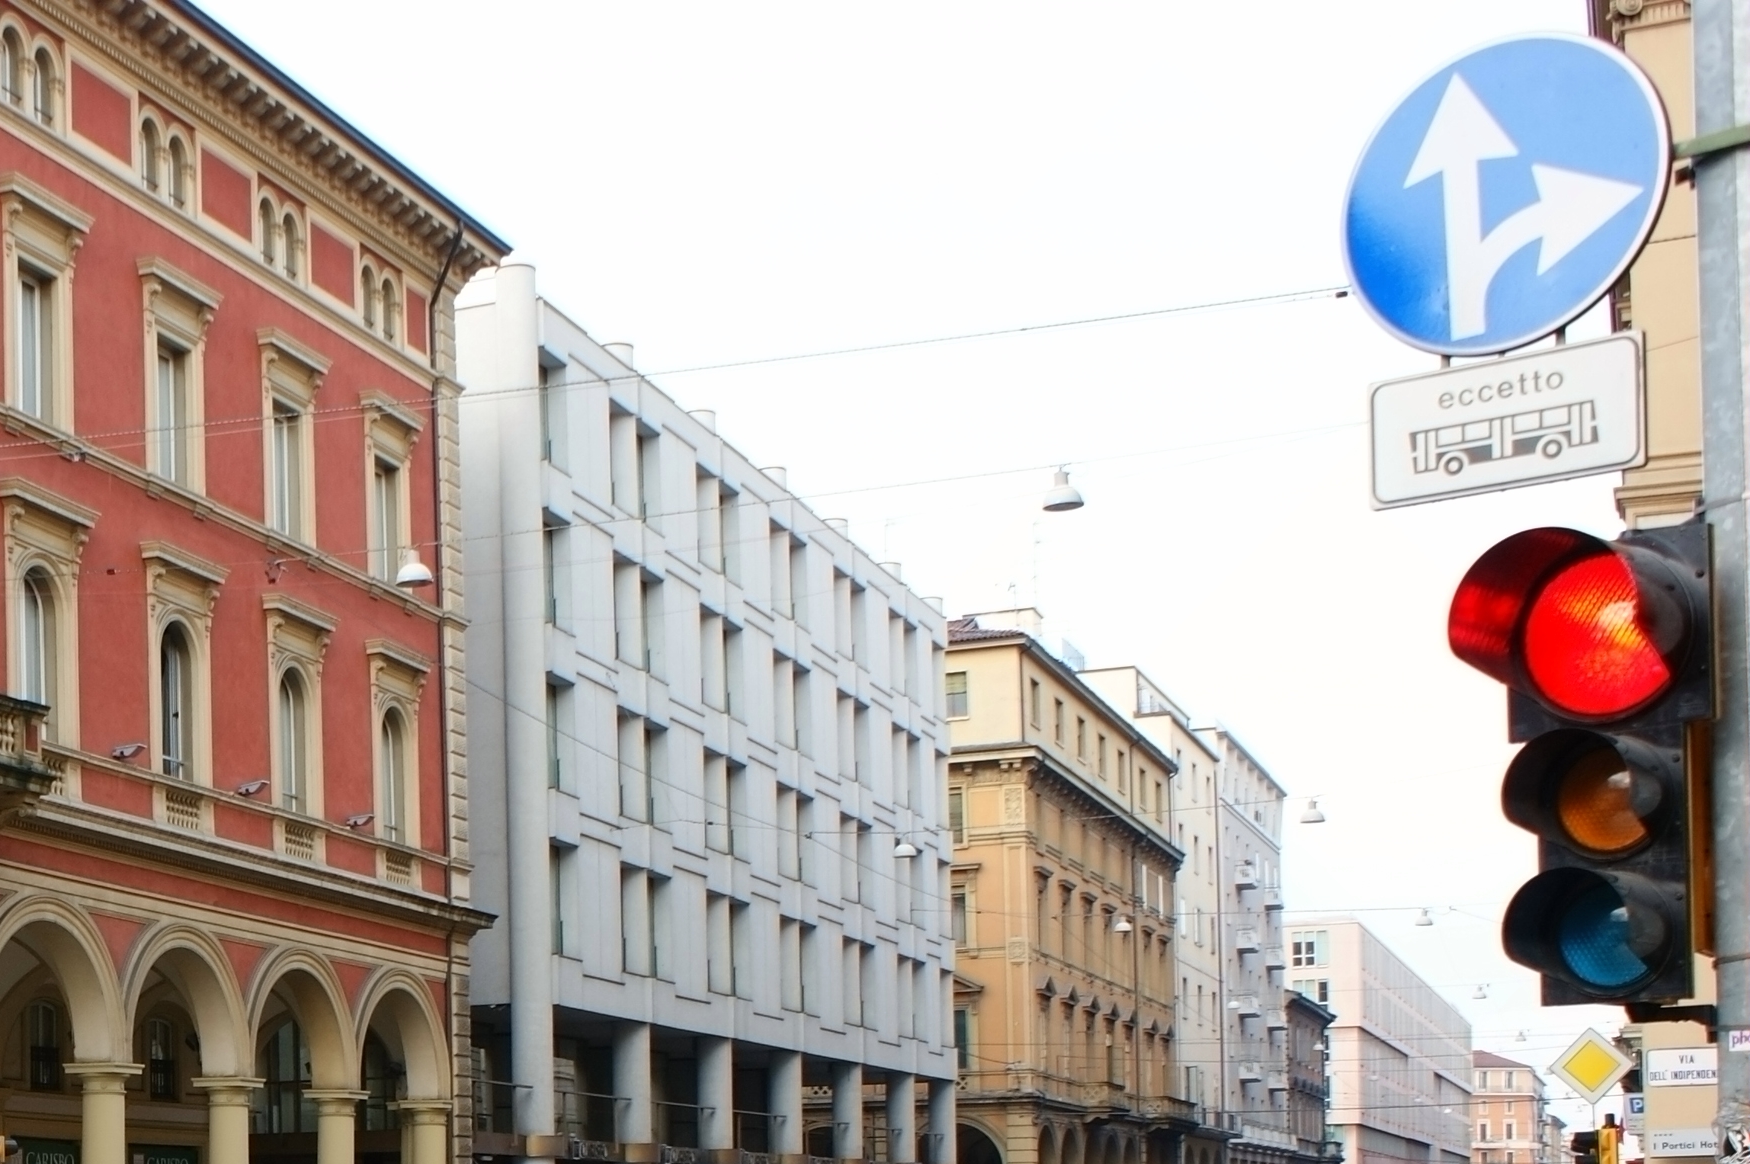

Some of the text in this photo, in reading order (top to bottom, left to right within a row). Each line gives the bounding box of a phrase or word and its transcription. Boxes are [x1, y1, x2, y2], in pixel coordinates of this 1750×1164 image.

[1437, 370, 1565, 410] eccetto
[1678, 1054, 1695, 1065] VIA
[1671, 1069, 1717, 1080] INDIPENDEN
[1662, 1141, 1695, 1150] Portici
[1700, 1141, 1718, 1149] Hot
